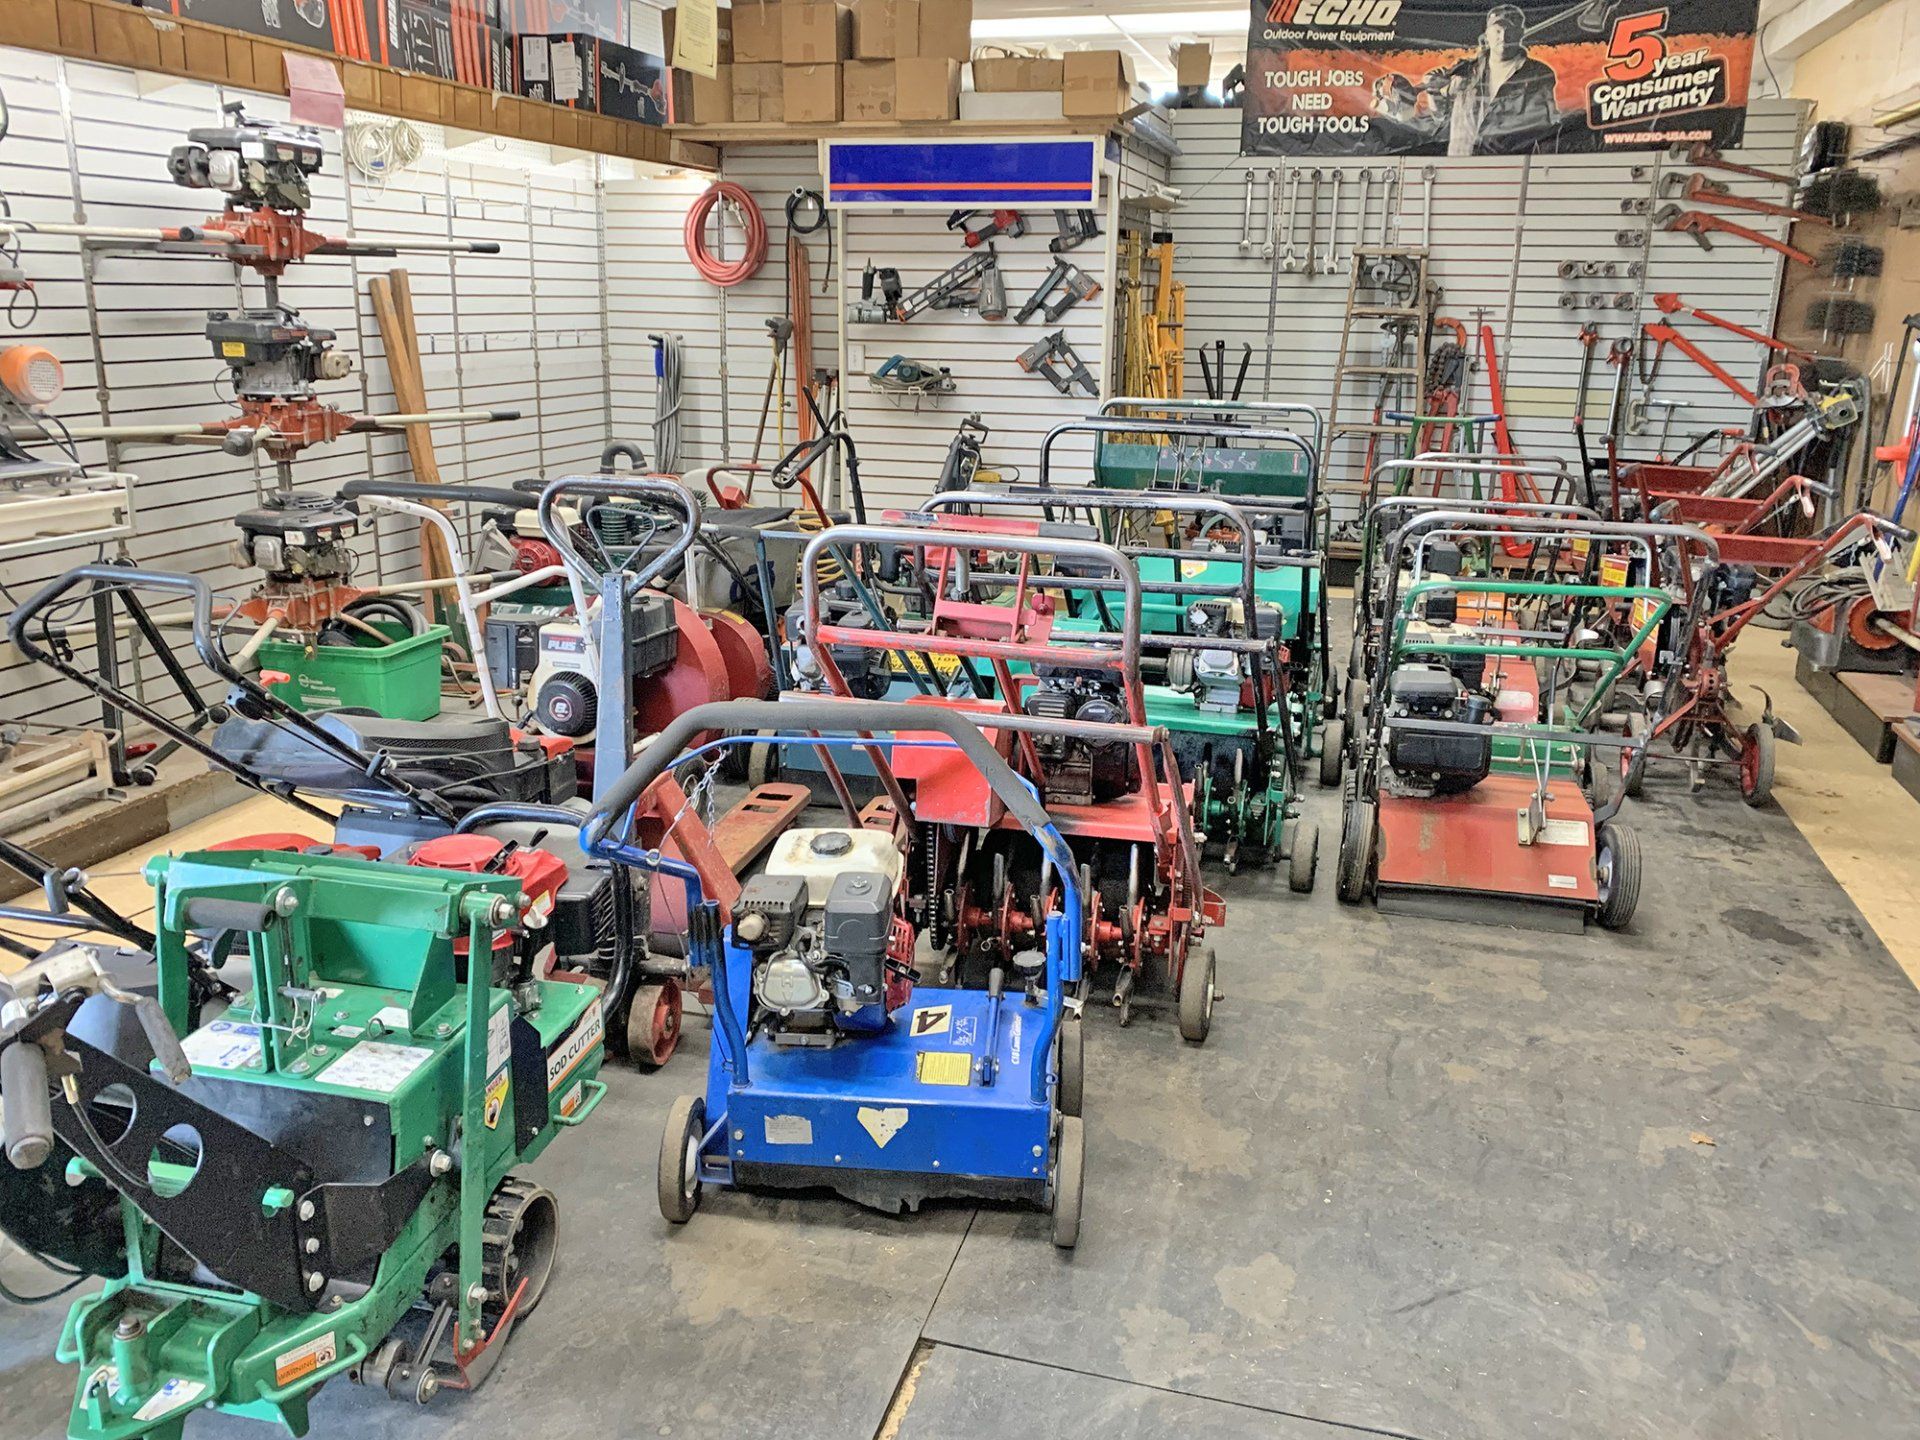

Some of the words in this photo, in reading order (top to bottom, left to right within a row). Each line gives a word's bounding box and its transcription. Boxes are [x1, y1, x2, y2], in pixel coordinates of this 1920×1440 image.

[1293, 0, 1402, 26] ECHO
[1263, 29, 1305, 40] Outdoor
[1306, 30, 1338, 40] Power
[1339, 30, 1395, 43] Equipment
[1603, 9, 1668, 82] 5
[1653, 49, 1710, 78] year
[1264, 70, 1321, 88] TOUGH
[1324, 70, 1364, 87] JOBS
[1593, 66, 1721, 104] Consumer
[1292, 93, 1333, 110] NEED
[1600, 85, 1716, 121] Warranty
[1258, 116, 1314, 134] TOUGH
[1317, 115, 1369, 133] TOOLS
[547, 639, 577, 650] PLUS
[917, 1010, 947, 1034] 4
[549, 1055, 567, 1081] SOD
[568, 1019, 601, 1060] CUTTER
